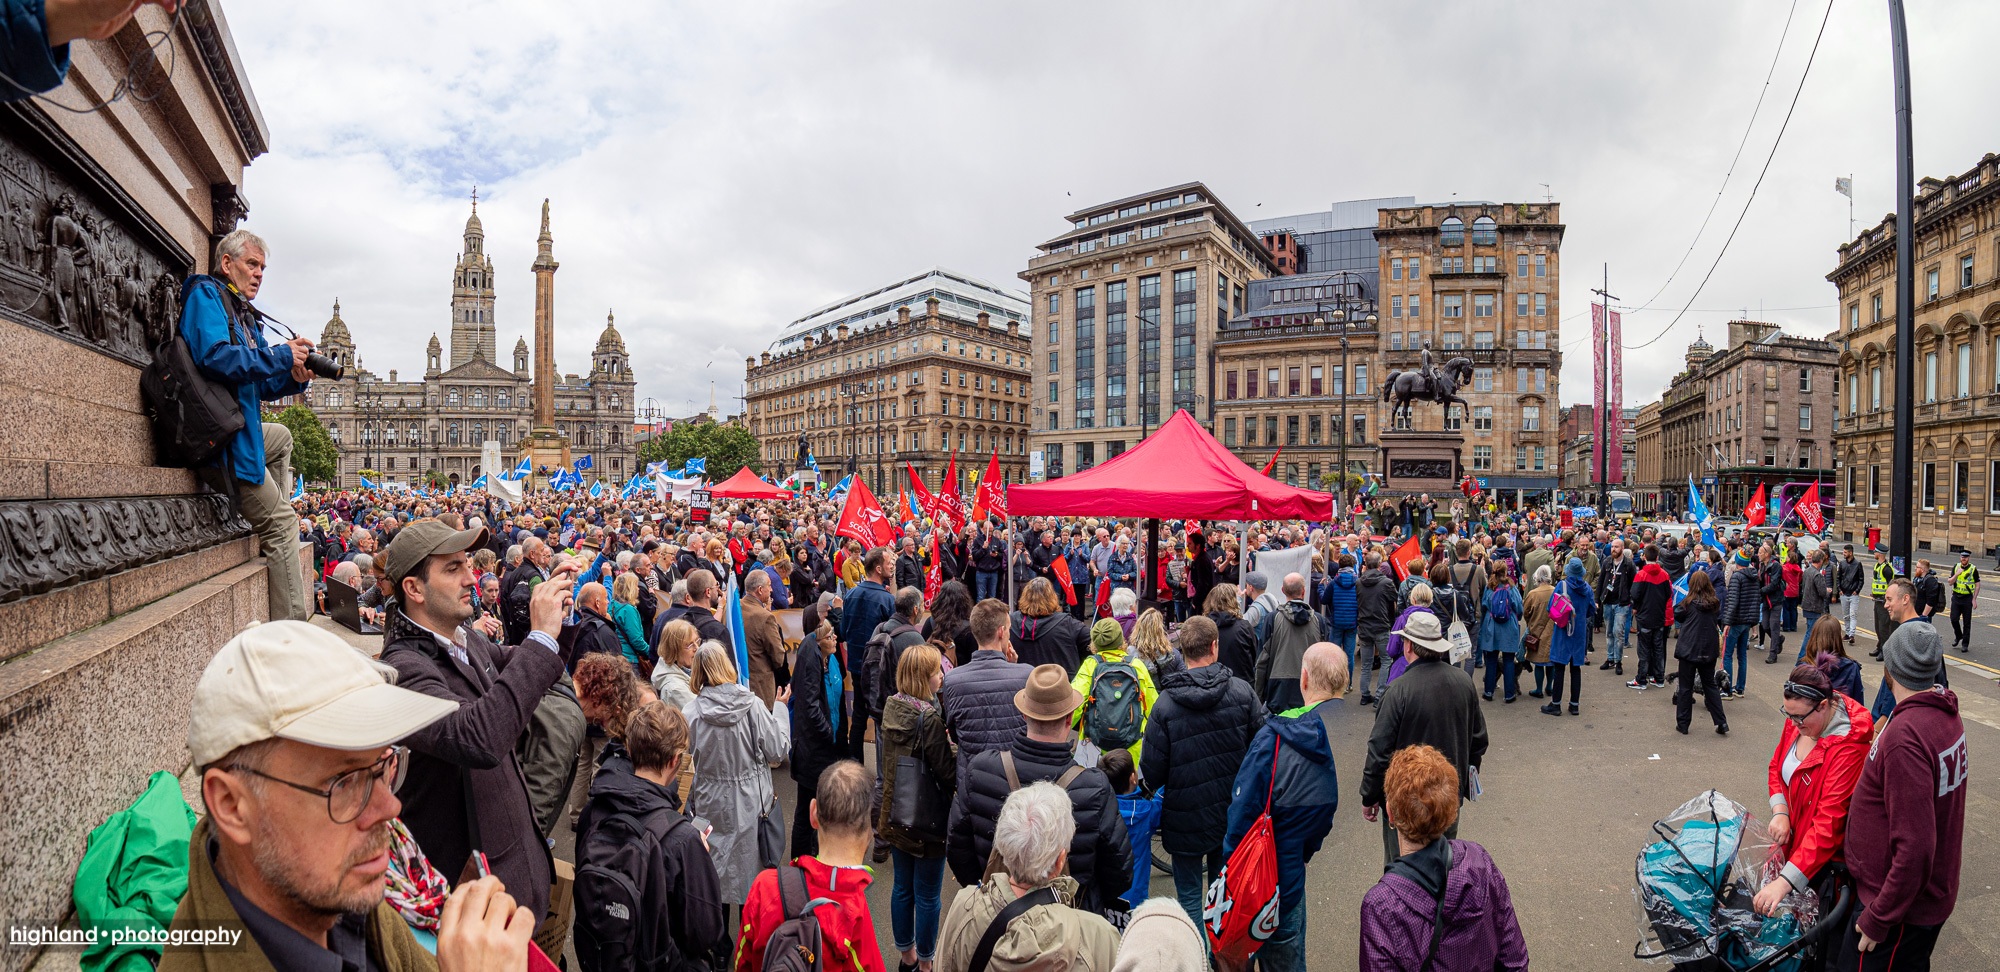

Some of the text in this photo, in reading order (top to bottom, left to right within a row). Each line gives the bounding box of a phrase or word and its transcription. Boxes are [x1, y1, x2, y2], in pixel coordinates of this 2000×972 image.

[691, 501, 711, 509] RACISM
[1798, 502, 1819, 531] SCOTLAND
[1943, 740, 1967, 787] YE
